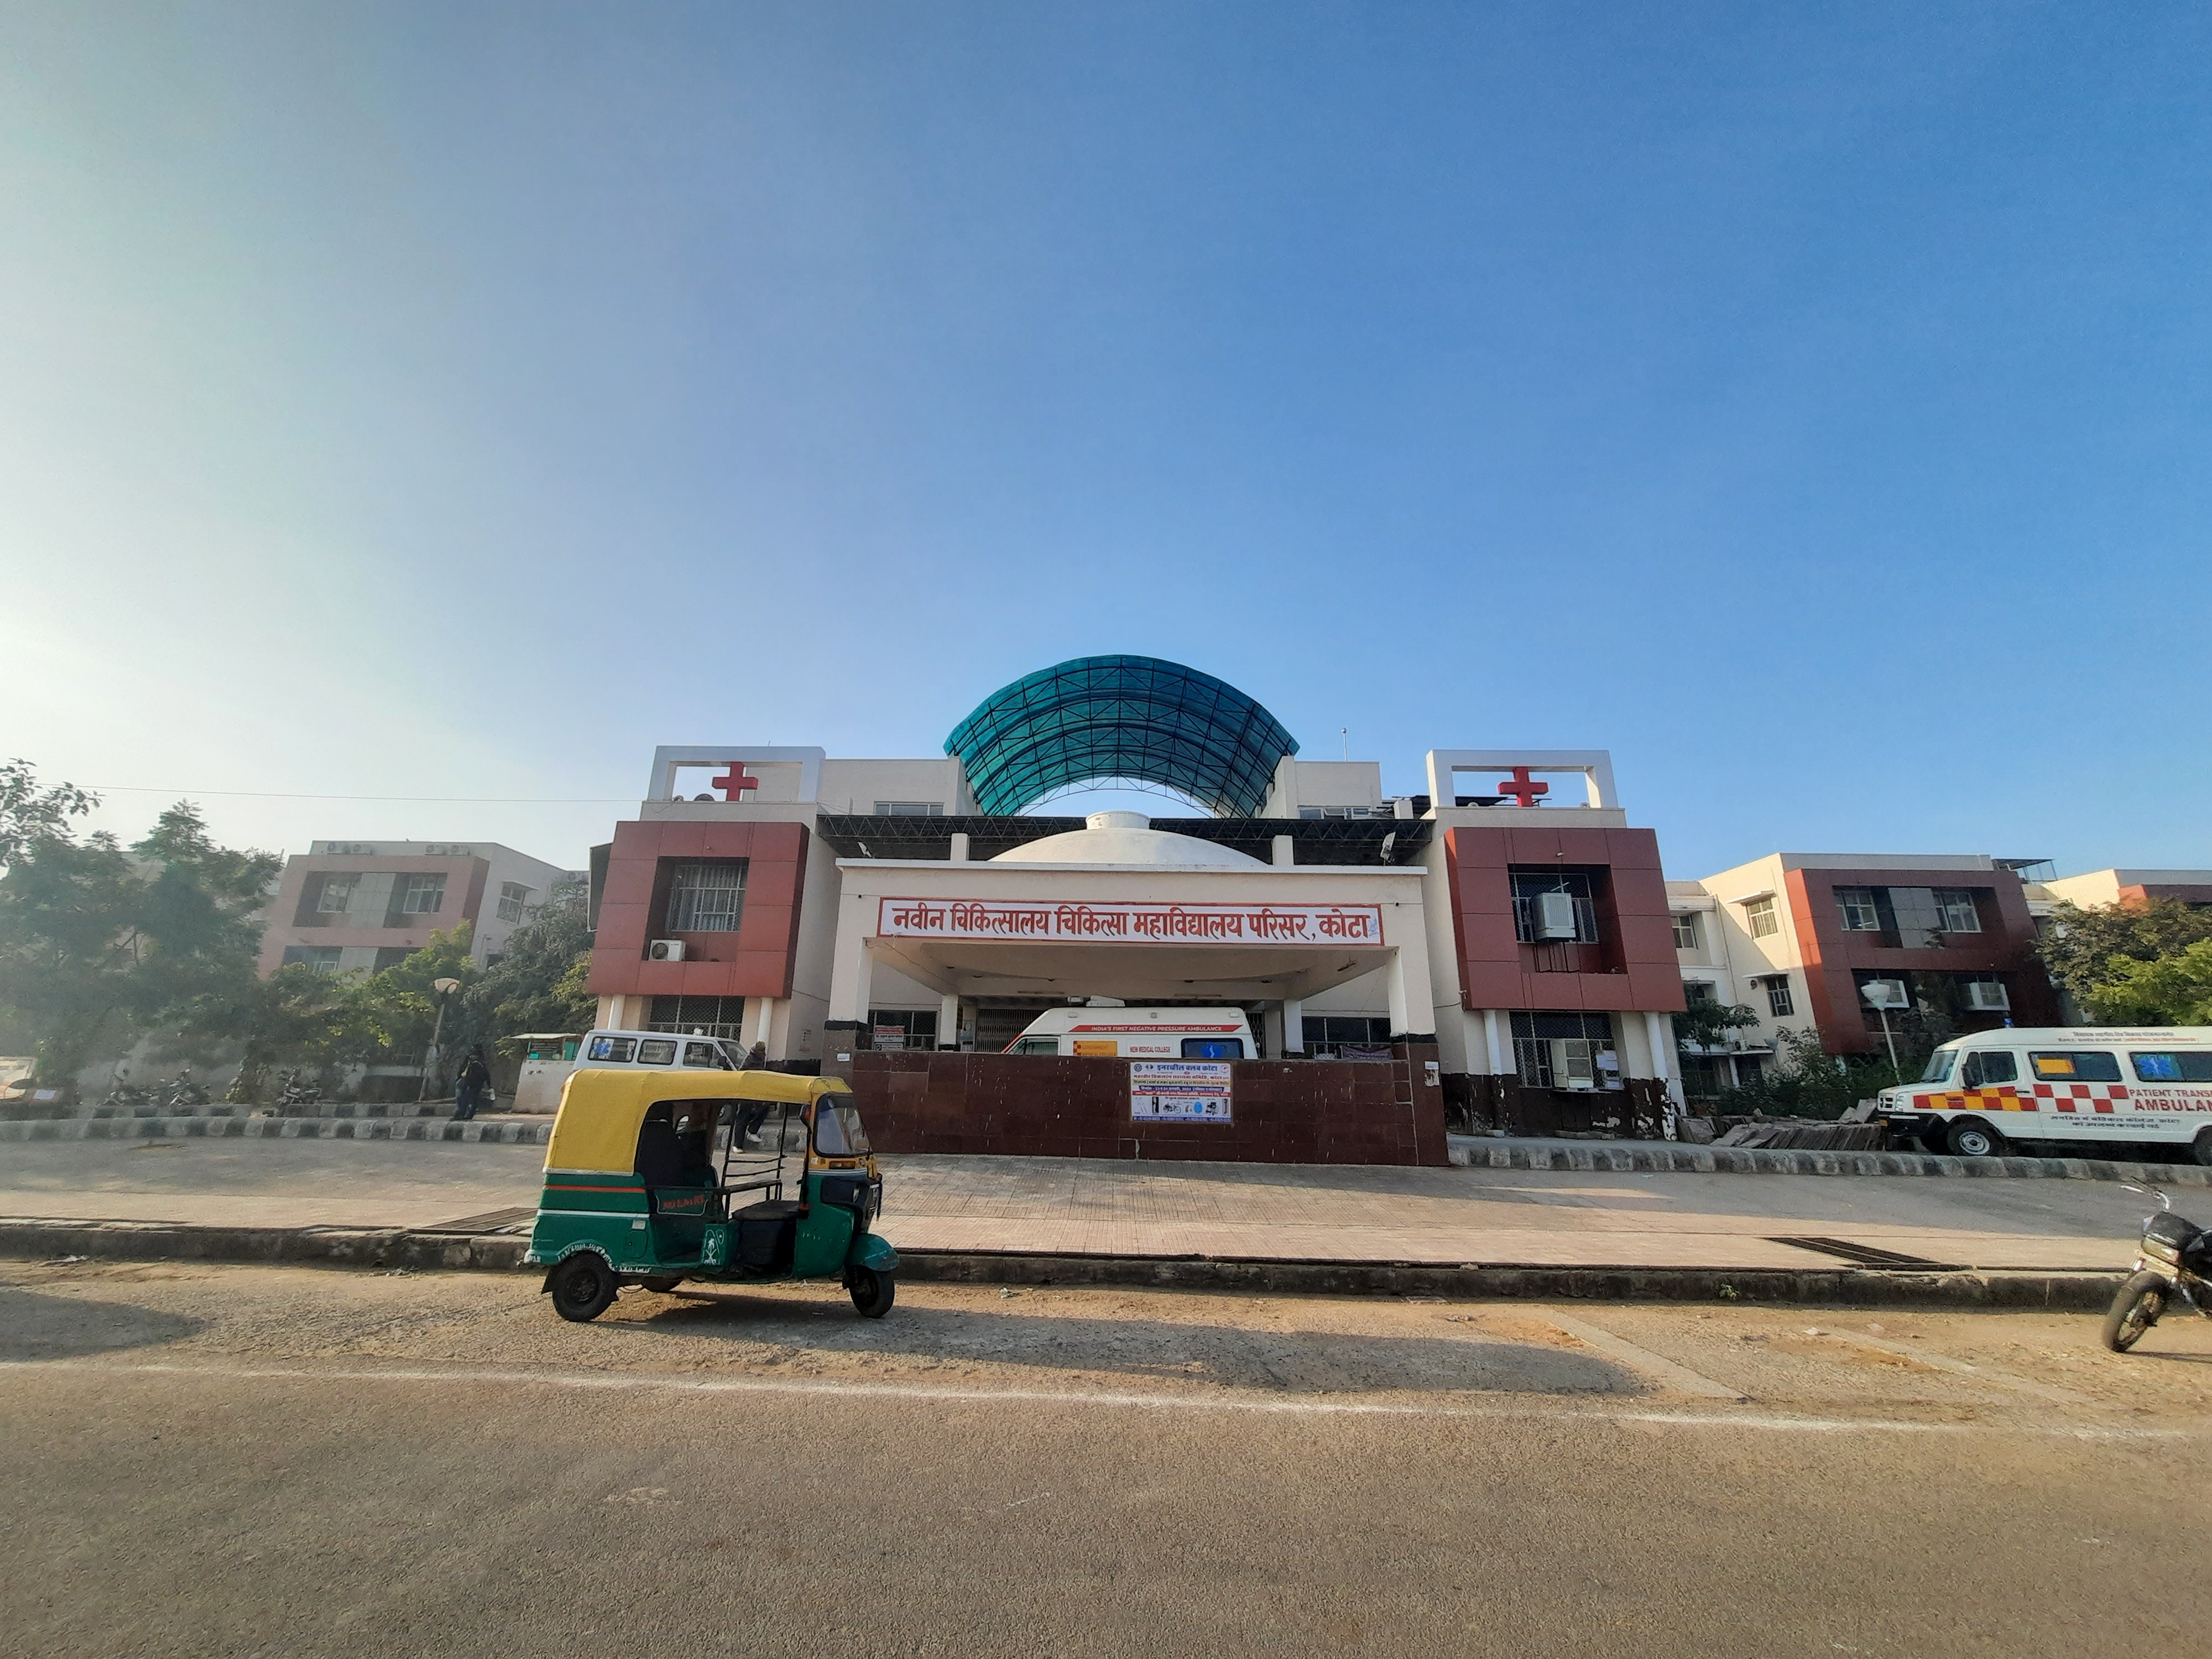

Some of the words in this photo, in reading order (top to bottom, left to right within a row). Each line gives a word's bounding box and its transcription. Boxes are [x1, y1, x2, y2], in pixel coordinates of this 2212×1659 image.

[891, 902, 946, 931] नवीन
[950, 902, 1052, 935] चिकित्सालय
[1054, 905, 1129, 936] चिकित्सा
[1133, 906, 1244, 940] महाविद्यालय
[1246, 907, 1317, 941] परिसर,
[1316, 908, 1371, 938] कोटा
